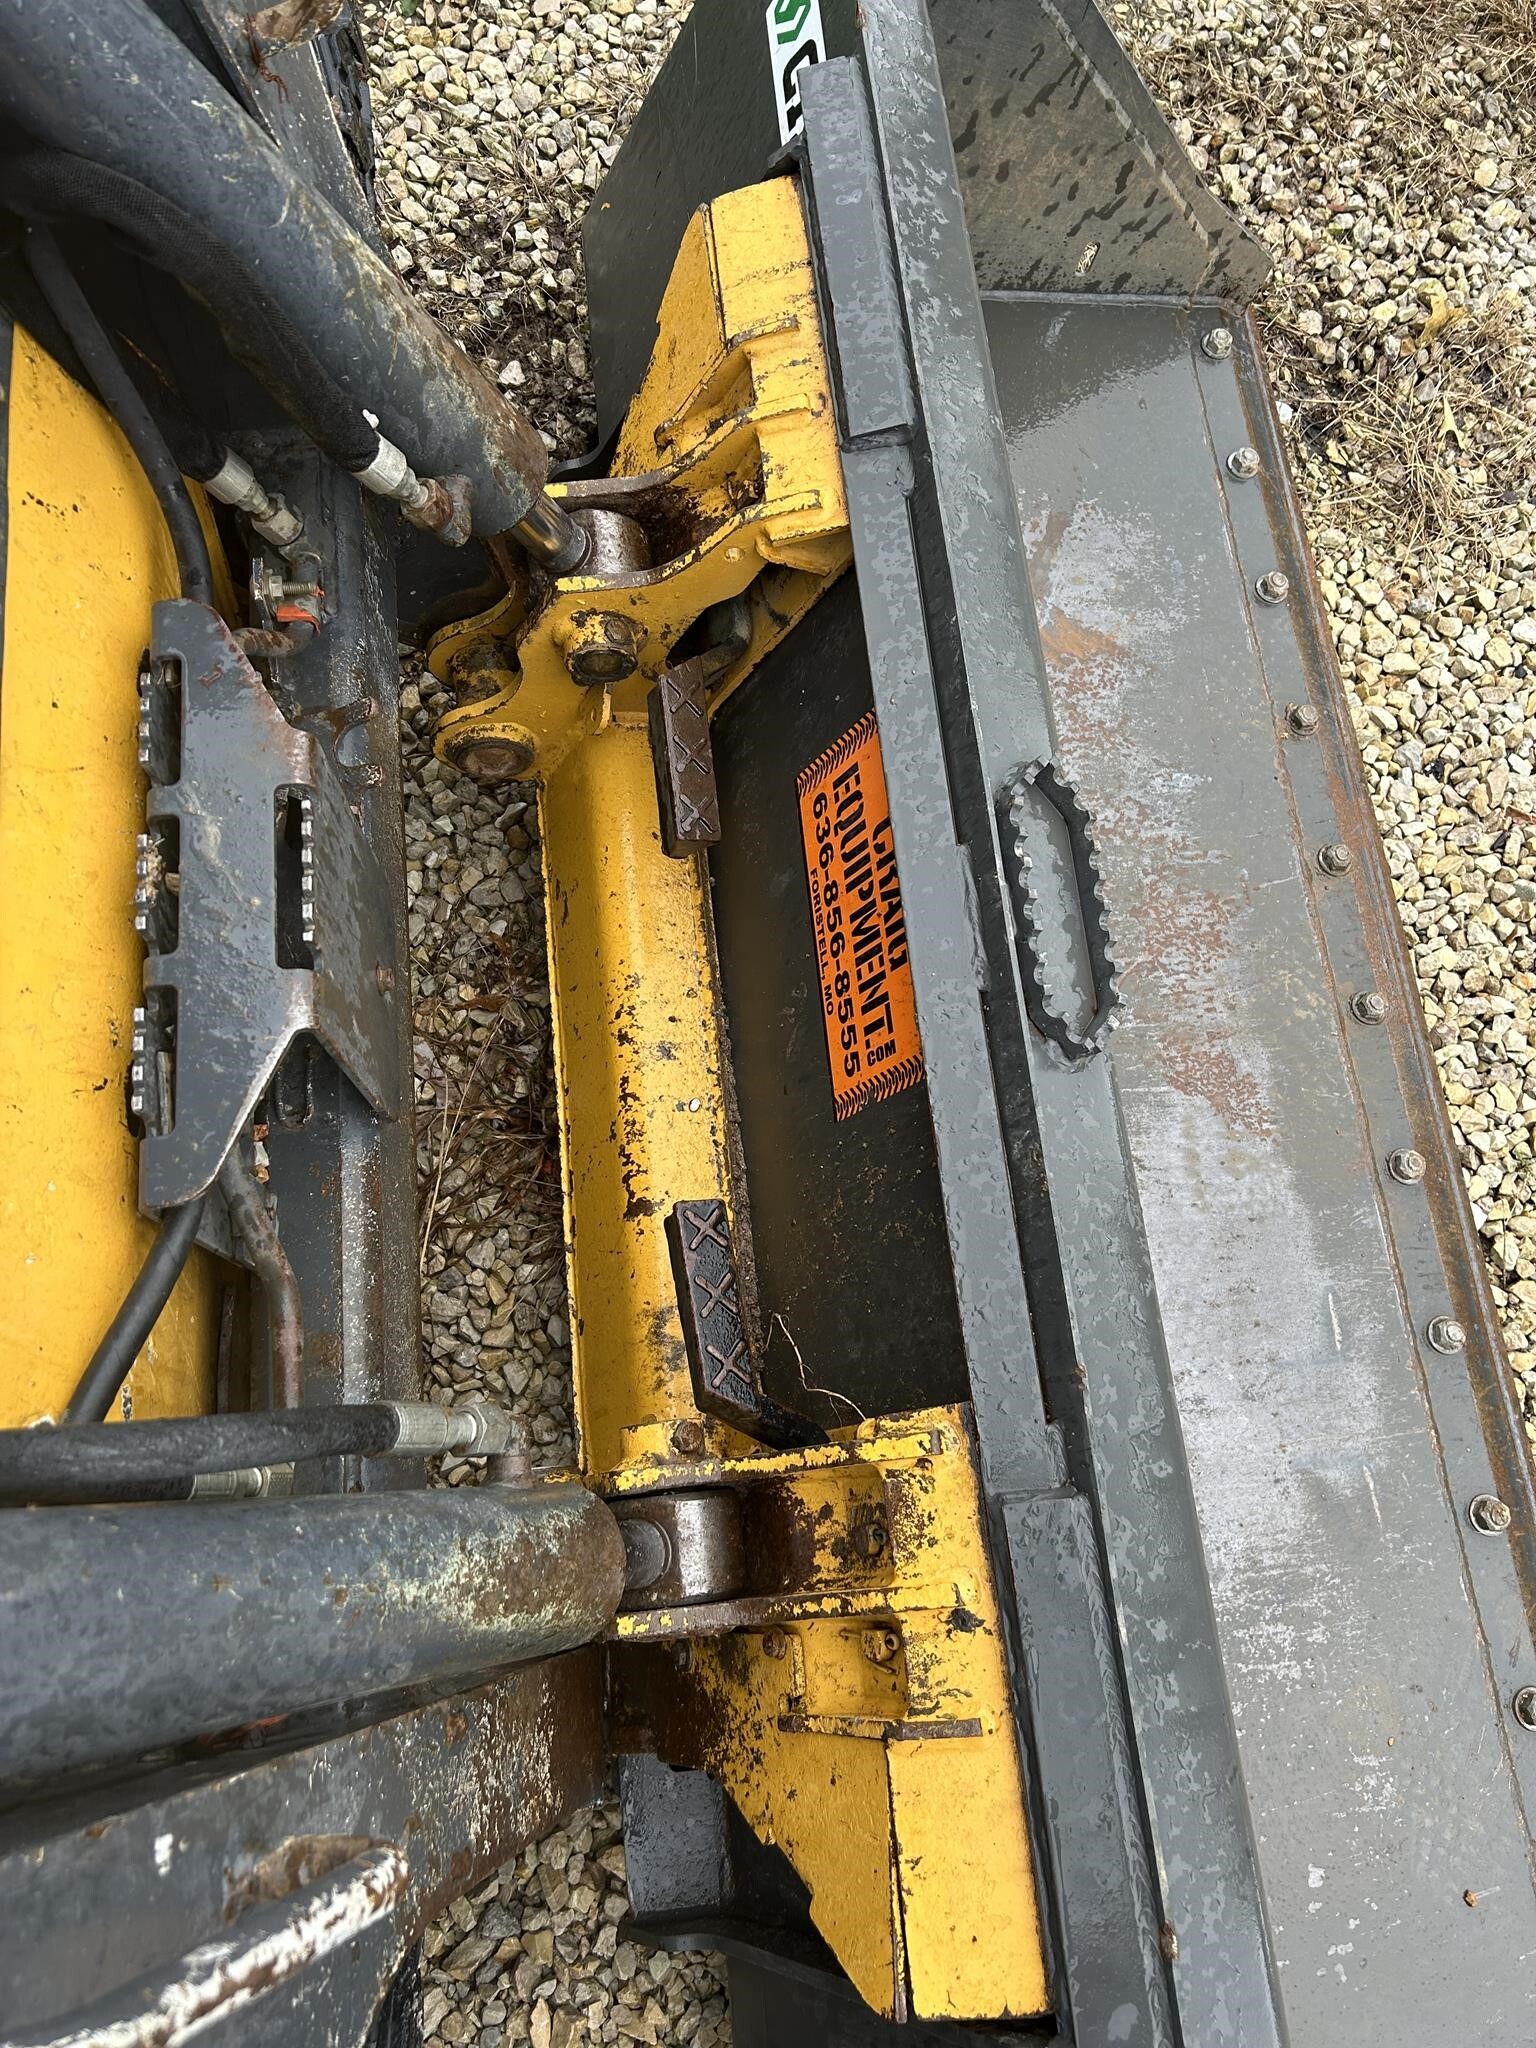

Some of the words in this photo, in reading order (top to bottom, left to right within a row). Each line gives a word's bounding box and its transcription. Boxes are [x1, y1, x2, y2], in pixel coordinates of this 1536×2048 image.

[810, 868, 829, 980] FORISTELL,
[824, 984, 834, 1016] MO
[813, 792, 860, 1078] 636-856-8555
